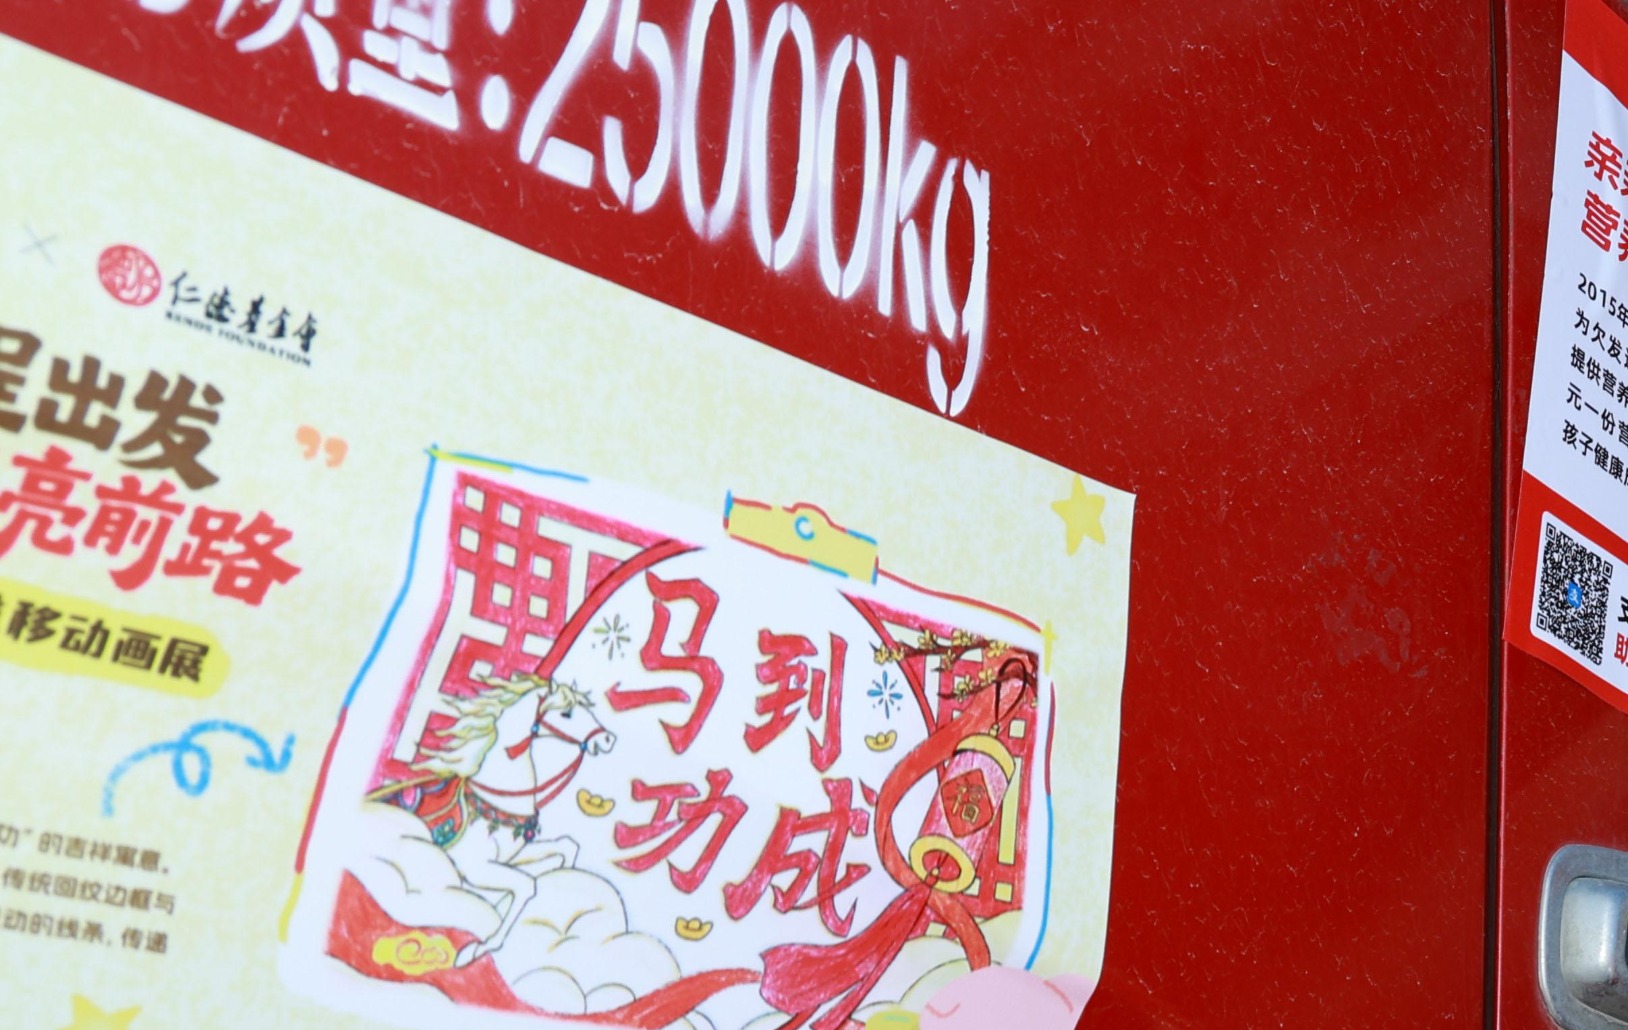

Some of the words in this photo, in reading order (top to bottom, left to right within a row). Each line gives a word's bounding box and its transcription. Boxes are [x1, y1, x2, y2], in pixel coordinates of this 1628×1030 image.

[218, 327, 313, 368] FOUNDATION
[604, 570, 848, 774] 马到
[614, 767, 880, 937] 功成
